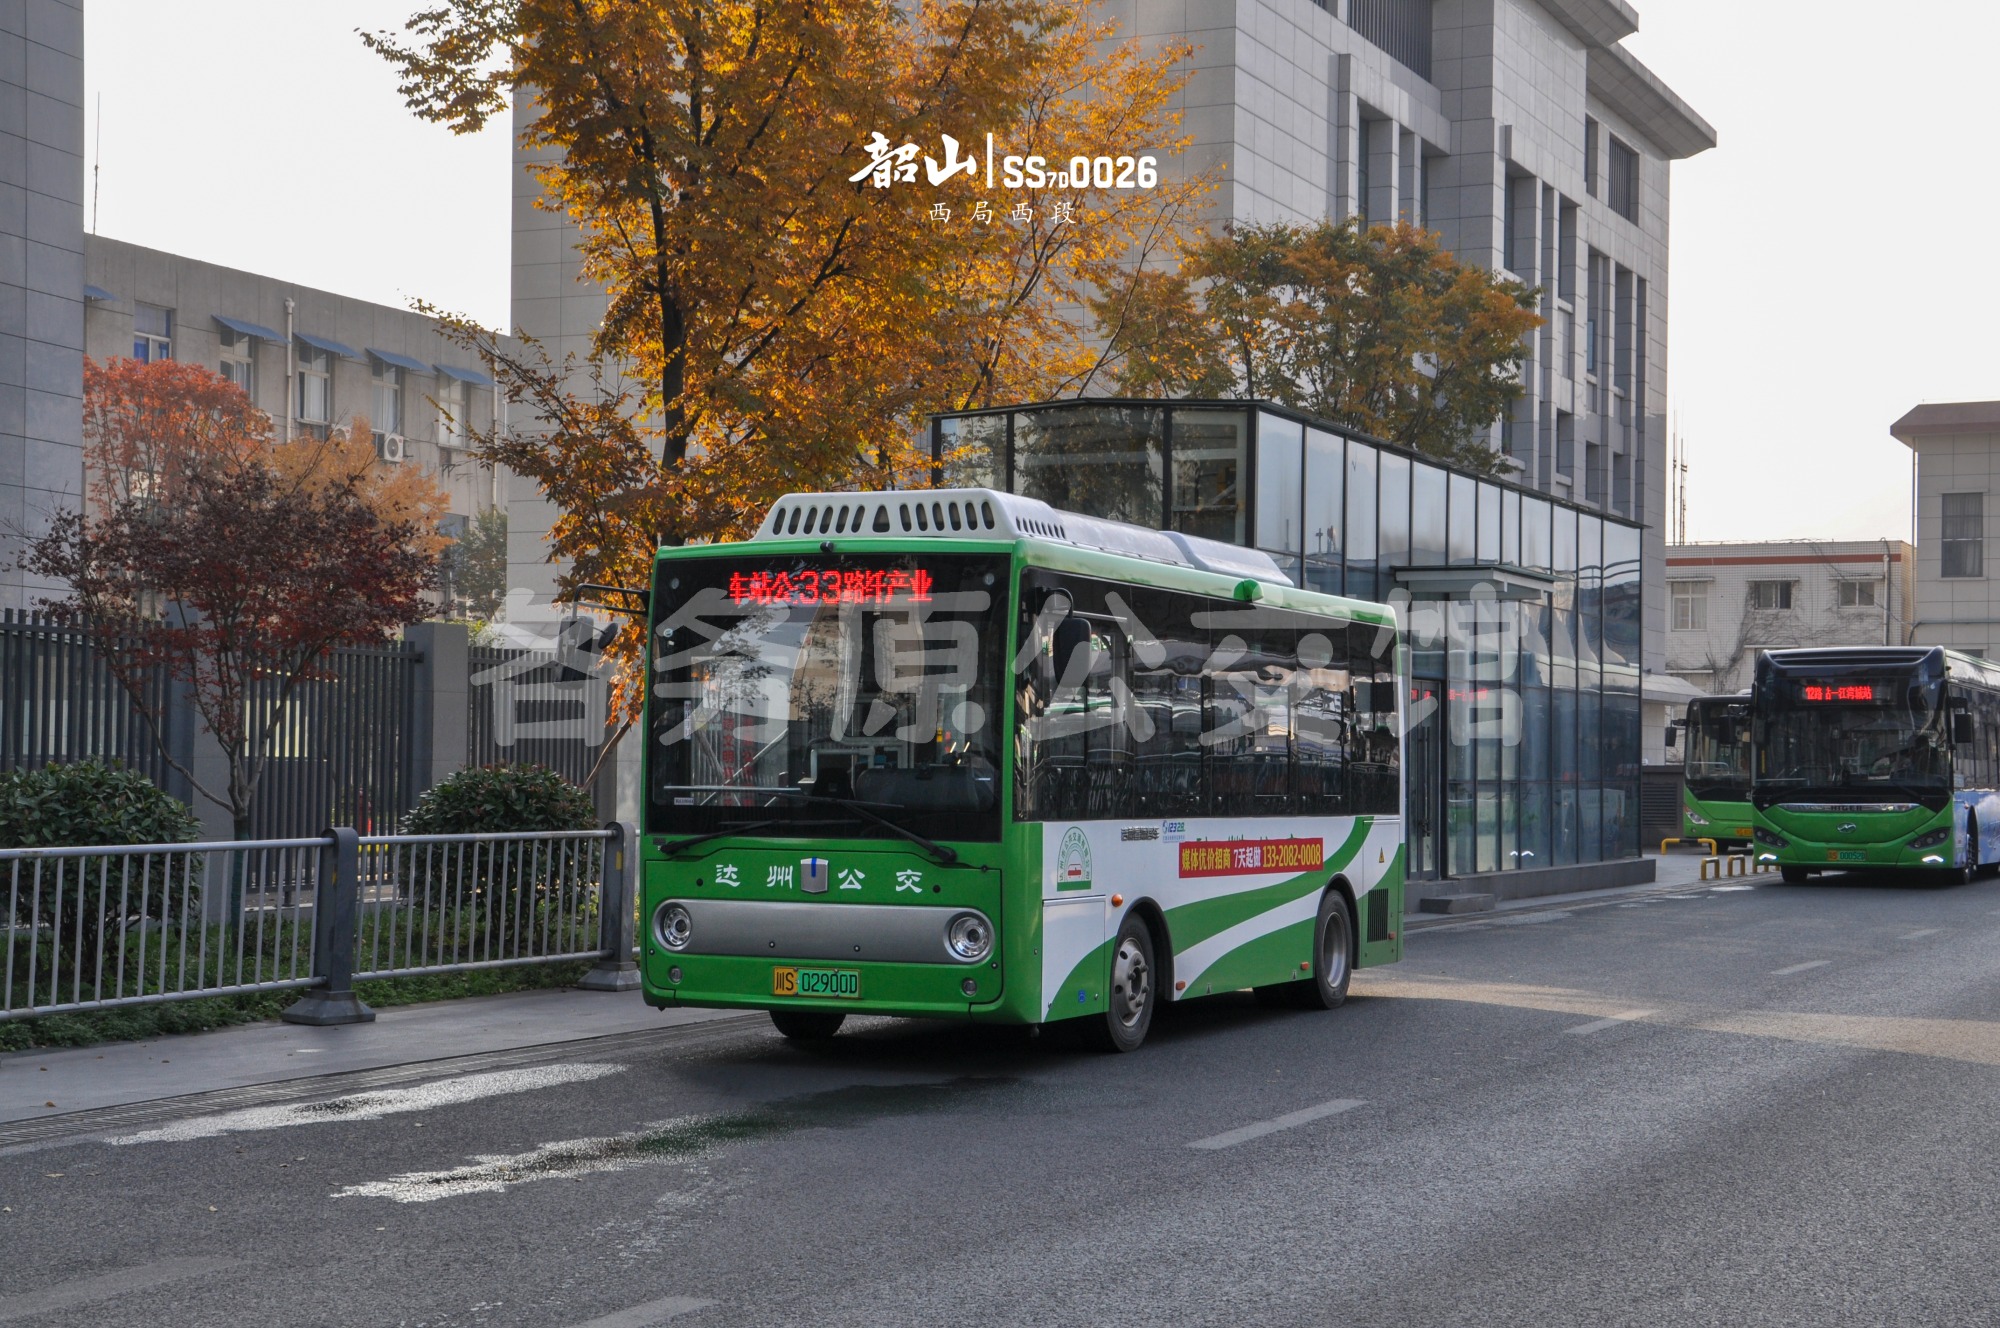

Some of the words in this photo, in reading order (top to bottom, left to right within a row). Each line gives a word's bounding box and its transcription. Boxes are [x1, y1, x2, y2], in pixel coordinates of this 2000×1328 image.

[1182, 848, 1231, 871] 媒体优价招商
[1262, 843, 1321, 868] 133-2082-0008
[715, 863, 923, 894] 达州公交
